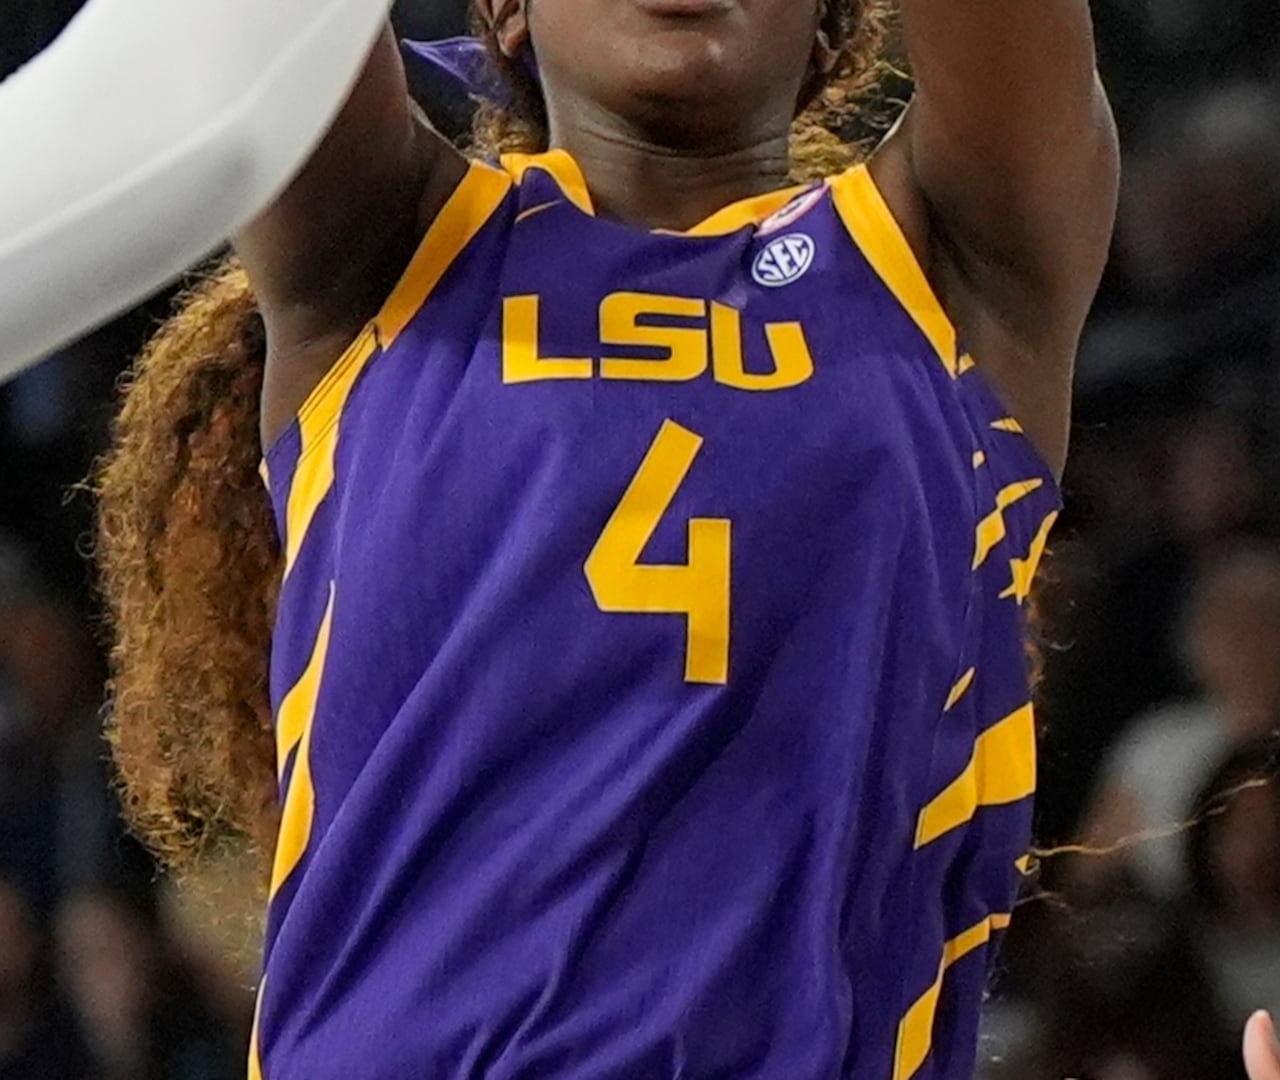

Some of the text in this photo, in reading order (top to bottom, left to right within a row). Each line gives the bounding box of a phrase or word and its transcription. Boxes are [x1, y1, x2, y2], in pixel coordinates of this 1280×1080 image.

[756, 237, 810, 280] SEC
[502, 291, 815, 392] LSU
[583, 418, 732, 685] 4
